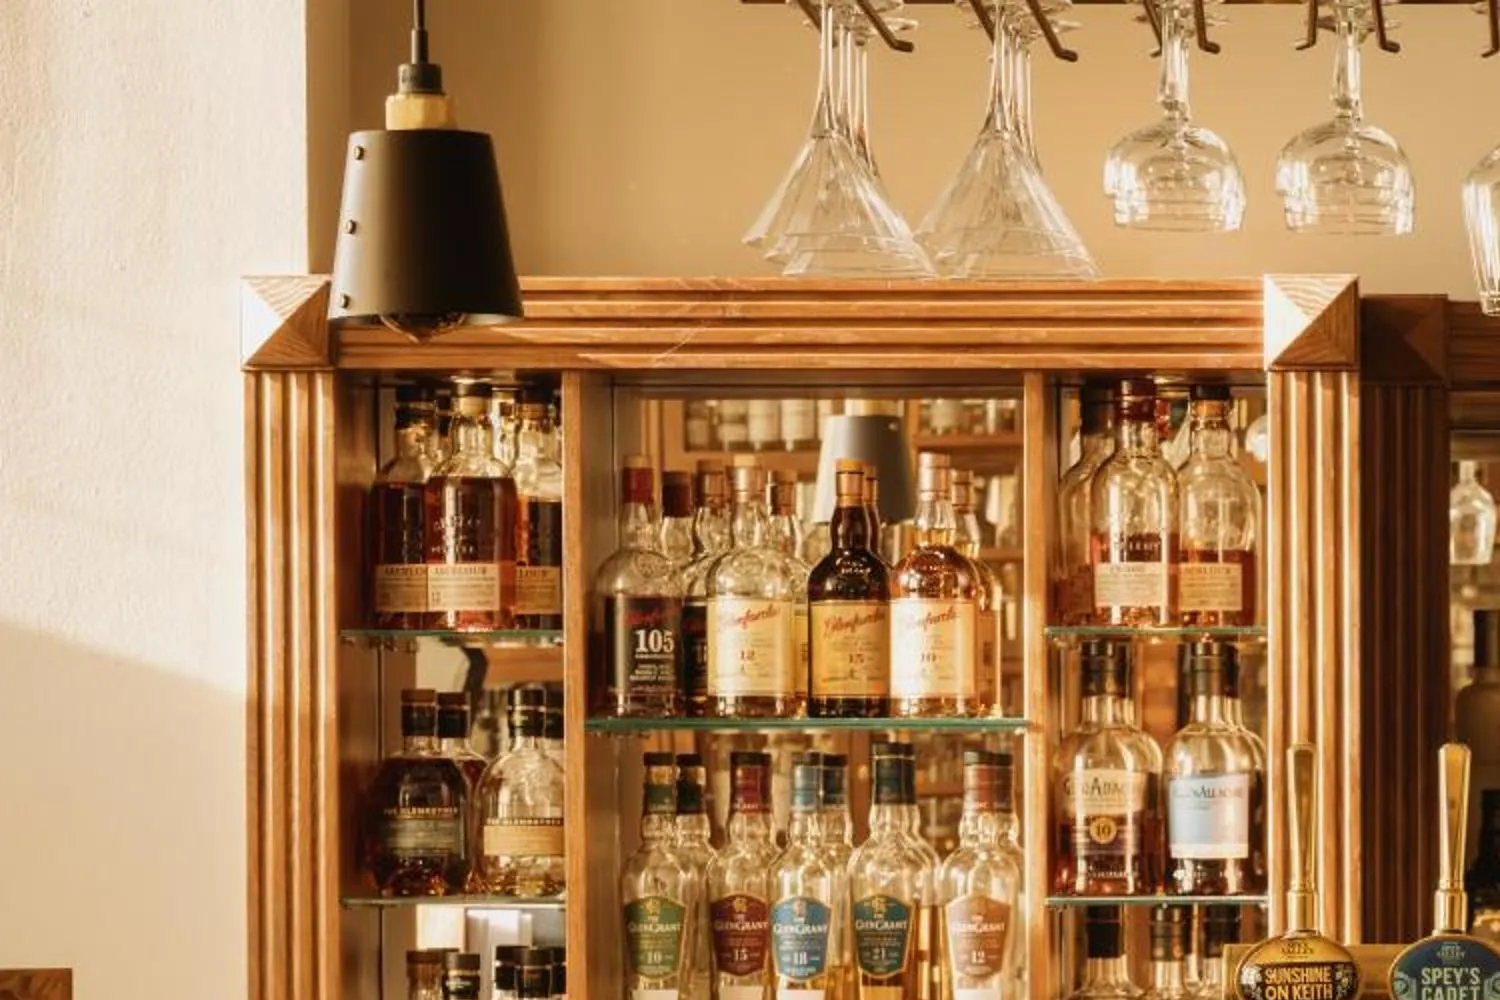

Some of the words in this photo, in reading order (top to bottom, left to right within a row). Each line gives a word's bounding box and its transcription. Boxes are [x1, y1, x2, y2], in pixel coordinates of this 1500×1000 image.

[634, 629, 675, 653] 105
[1095, 824, 1112, 836] 10
[646, 952, 662, 963] 10
[733, 950, 748, 962] 15
[871, 949, 886, 961] 21
[1265, 965, 1332, 985] SUNSHINE
[1421, 967, 1481, 985] SPEY'S
[1265, 984, 1290, 1000] ON
[1292, 983, 1333, 1000] KEITH
